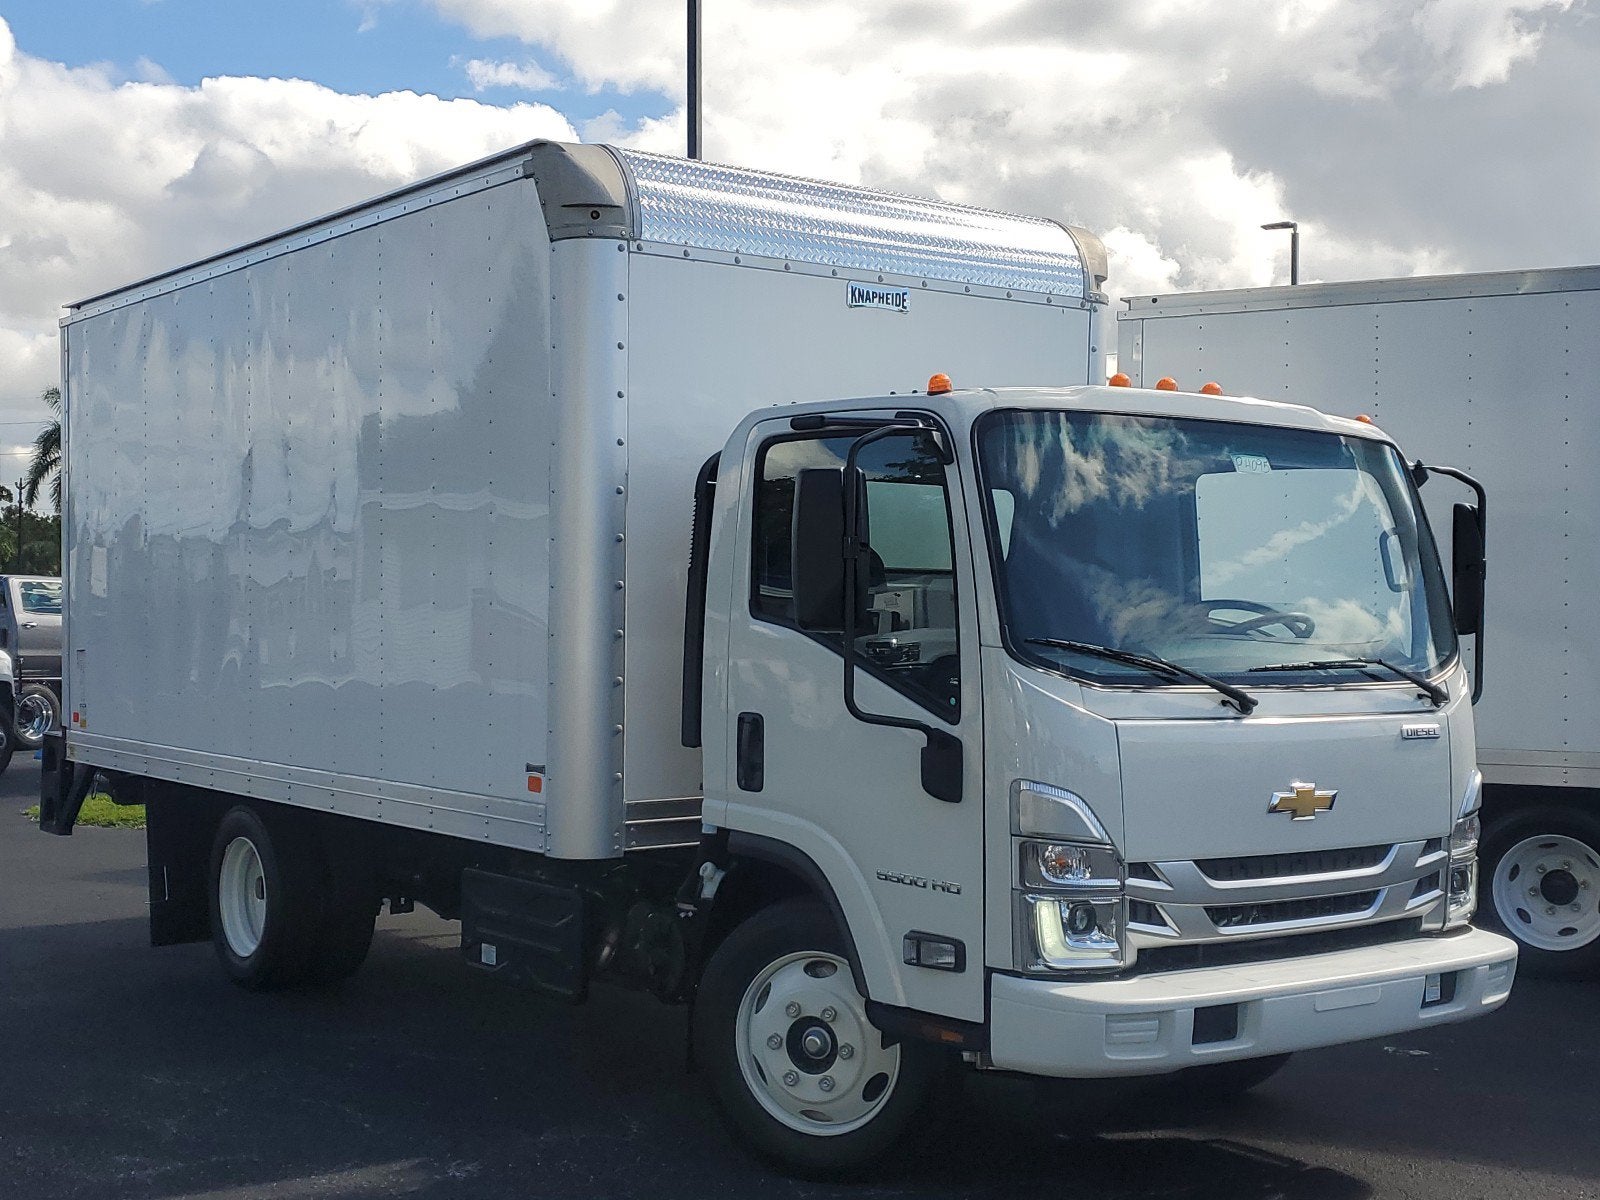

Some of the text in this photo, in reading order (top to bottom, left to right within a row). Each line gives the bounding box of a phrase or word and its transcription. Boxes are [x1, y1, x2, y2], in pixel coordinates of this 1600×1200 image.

[850, 285, 908, 309] KNAPHEIDE
[1405, 727, 1440, 737] DIESEL
[931, 878, 962, 895] HD
